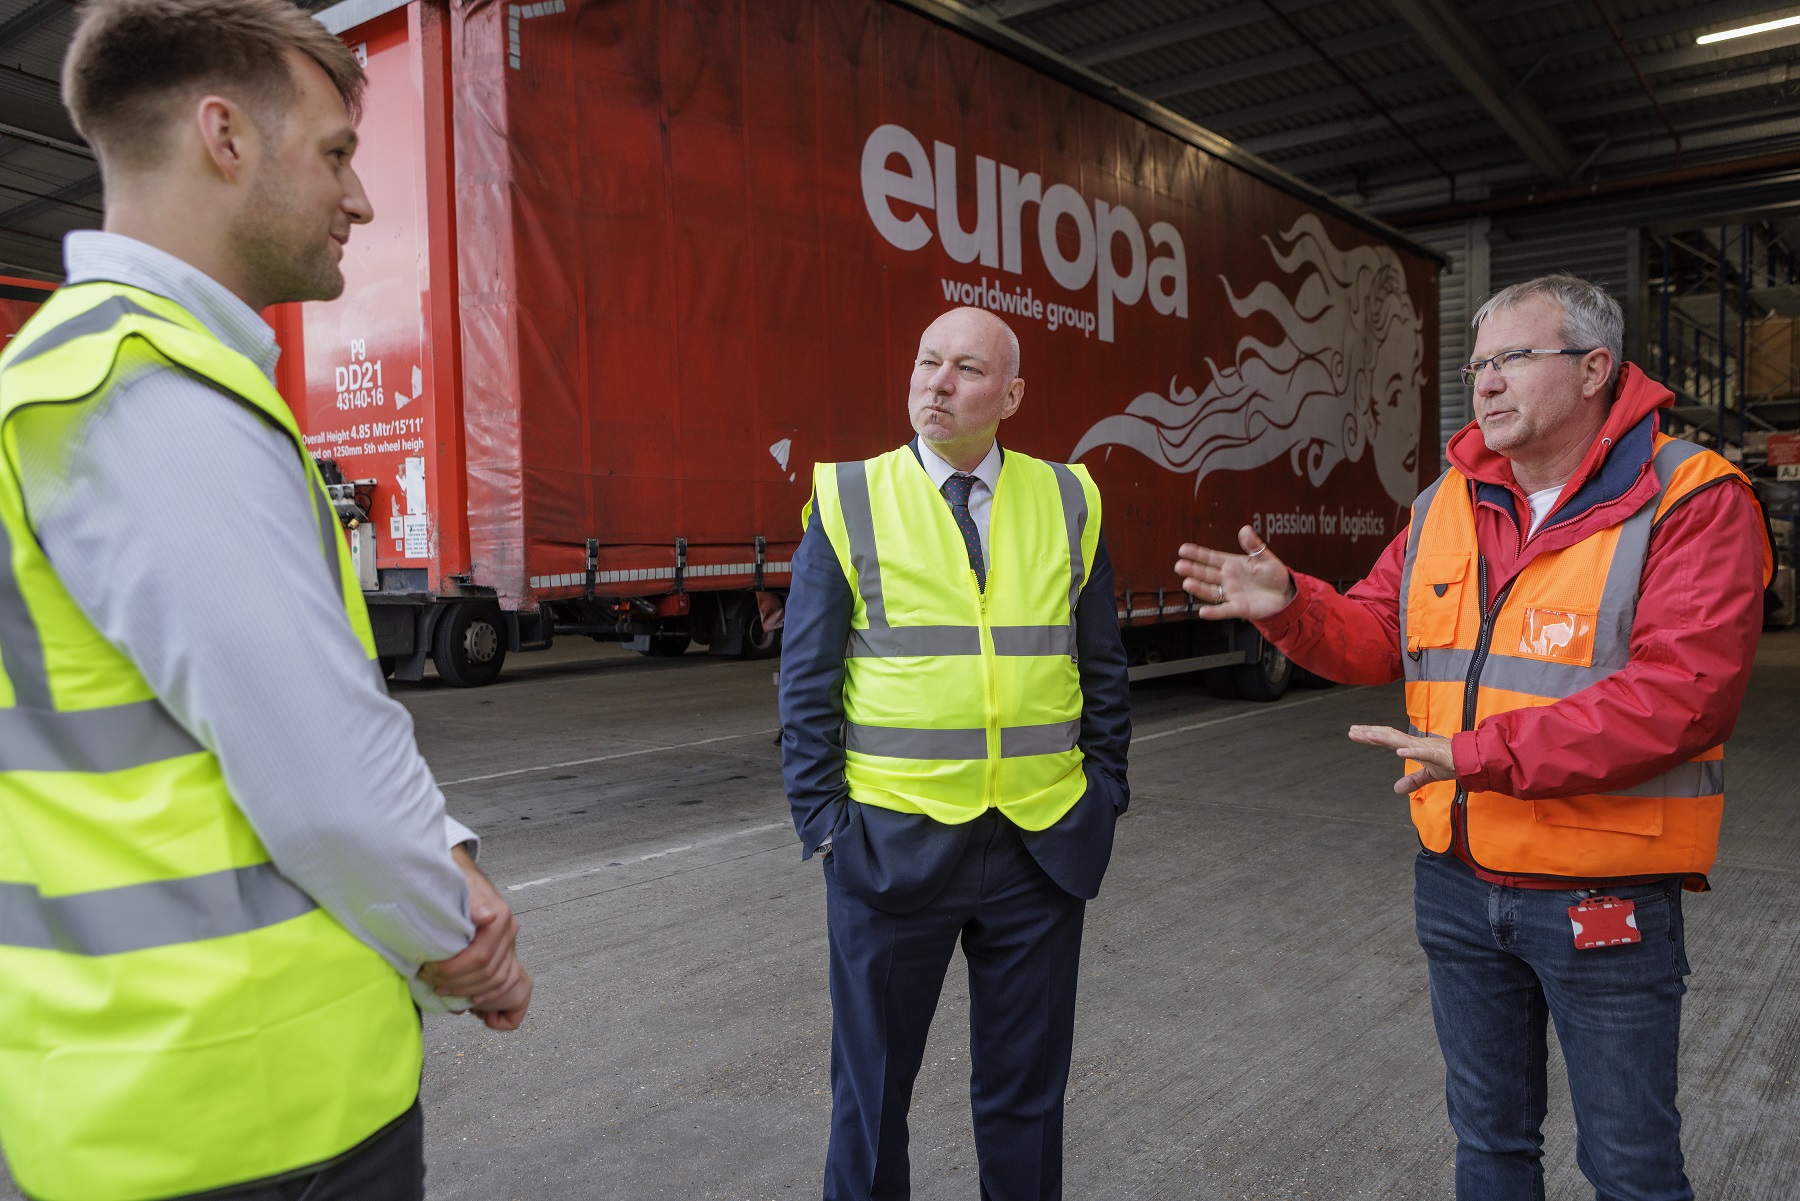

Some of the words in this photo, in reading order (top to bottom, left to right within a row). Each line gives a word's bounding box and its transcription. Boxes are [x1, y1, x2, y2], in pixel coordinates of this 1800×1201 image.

[860, 123, 1188, 343] europa
[941, 276, 1043, 320] worldwide
[1046, 302, 1096, 338] group
[350, 338, 366, 362] P9
[335, 359, 382, 393] DD21
[336, 386, 384, 411] 43140-16
[302, 431, 325, 445] Overall
[326, 429, 350, 444] Height
[350, 423, 371, 440] 4.85
[307, 447, 321, 460] sed
[322, 449, 332, 459] on
[333, 444, 362, 458] 1250mm
[363, 442, 376, 455] 5th
[377, 439, 400, 453] wheel
[401, 436, 424, 453] heigh
[1253, 512, 1262, 535] a
[1266, 505, 1316, 543] passion
[1319, 505, 1337, 535] for
[1340, 507, 1385, 543] logistics
